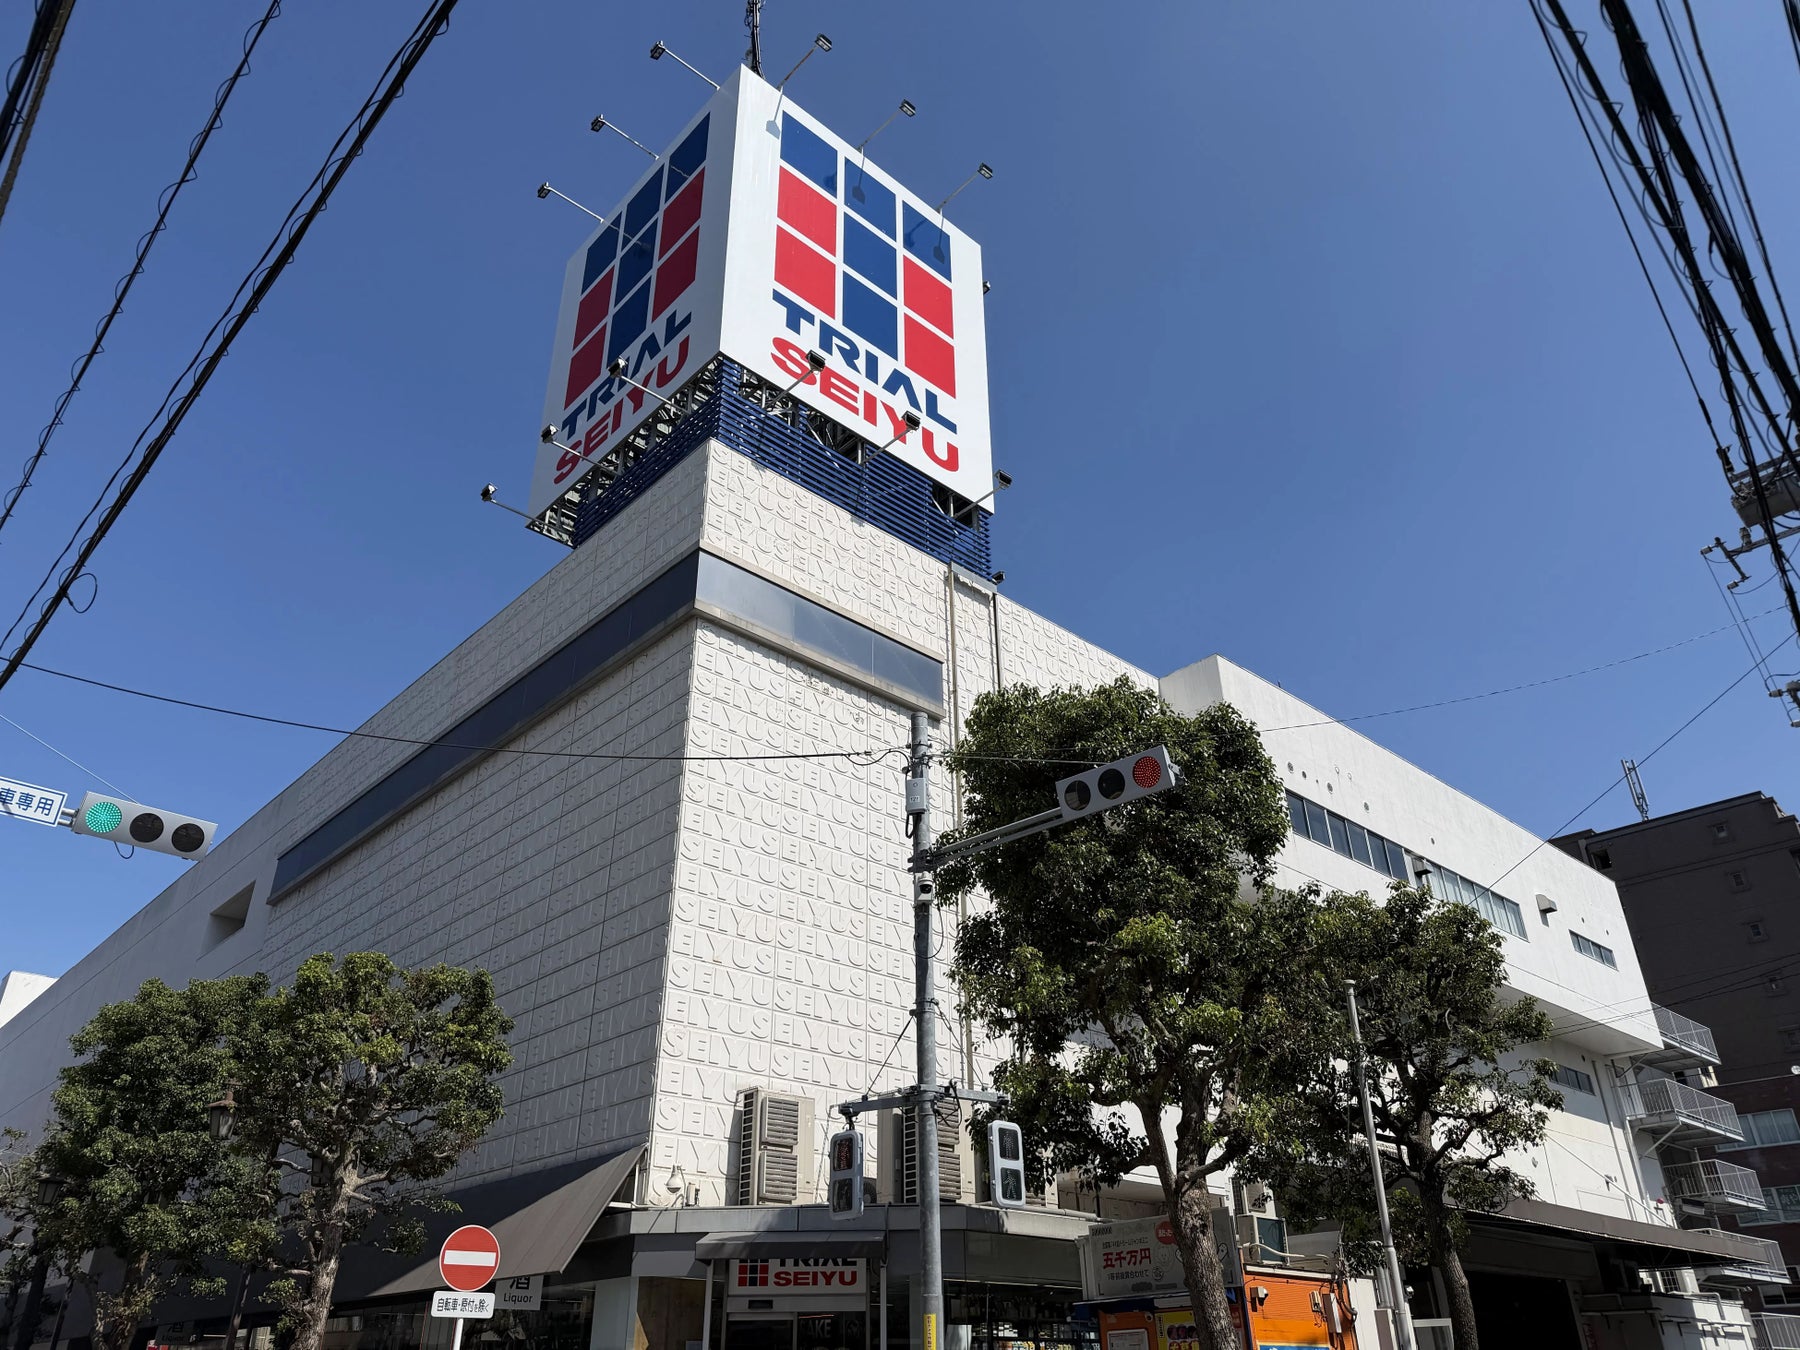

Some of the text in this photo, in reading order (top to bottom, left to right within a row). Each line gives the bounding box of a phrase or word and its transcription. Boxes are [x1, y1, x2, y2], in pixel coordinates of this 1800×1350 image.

[554, 335, 690, 485] SEIYU
[561, 310, 692, 441] TRIAL
[771, 337, 959, 472] SEIYU
[772, 288, 957, 435] TRIAL
[504, 1292, 533, 1304] Liquor
[773, 1271, 857, 1286] SEIYU
[1103, 1247, 1152, 1269] 五千万円
